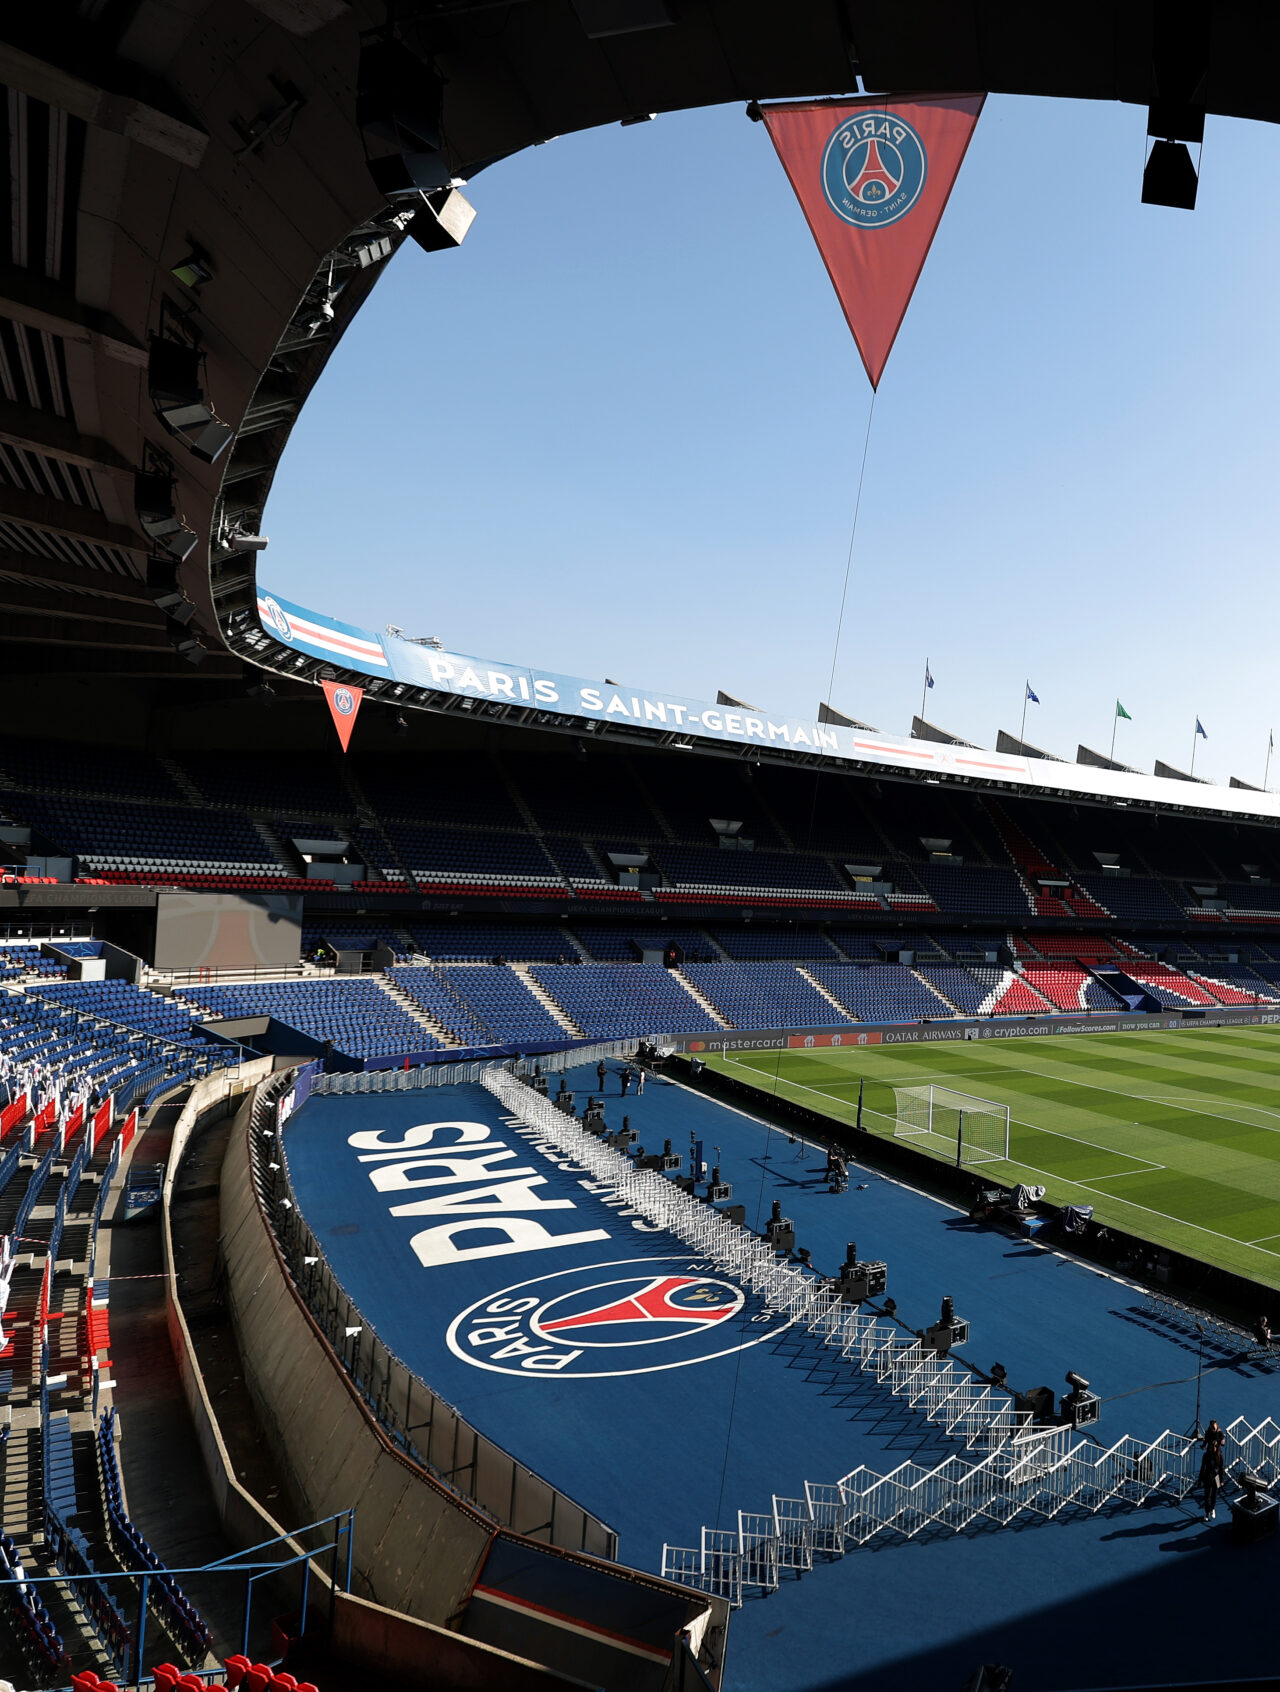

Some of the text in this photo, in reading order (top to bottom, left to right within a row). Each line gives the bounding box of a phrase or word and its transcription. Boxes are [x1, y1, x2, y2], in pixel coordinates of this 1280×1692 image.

[426, 656, 839, 750] PARIS SAINT-GERMAIN
[994, 1025, 1048, 1038] crypto.com
[1136, 1023, 1148, 1031] you
[886, 1029, 962, 1043] QATAR AIRWAYS
[709, 1037, 784, 1050] mastercard
[347, 1121, 612, 1268] PARIS
[467, 1296, 584, 1370] PARIS
